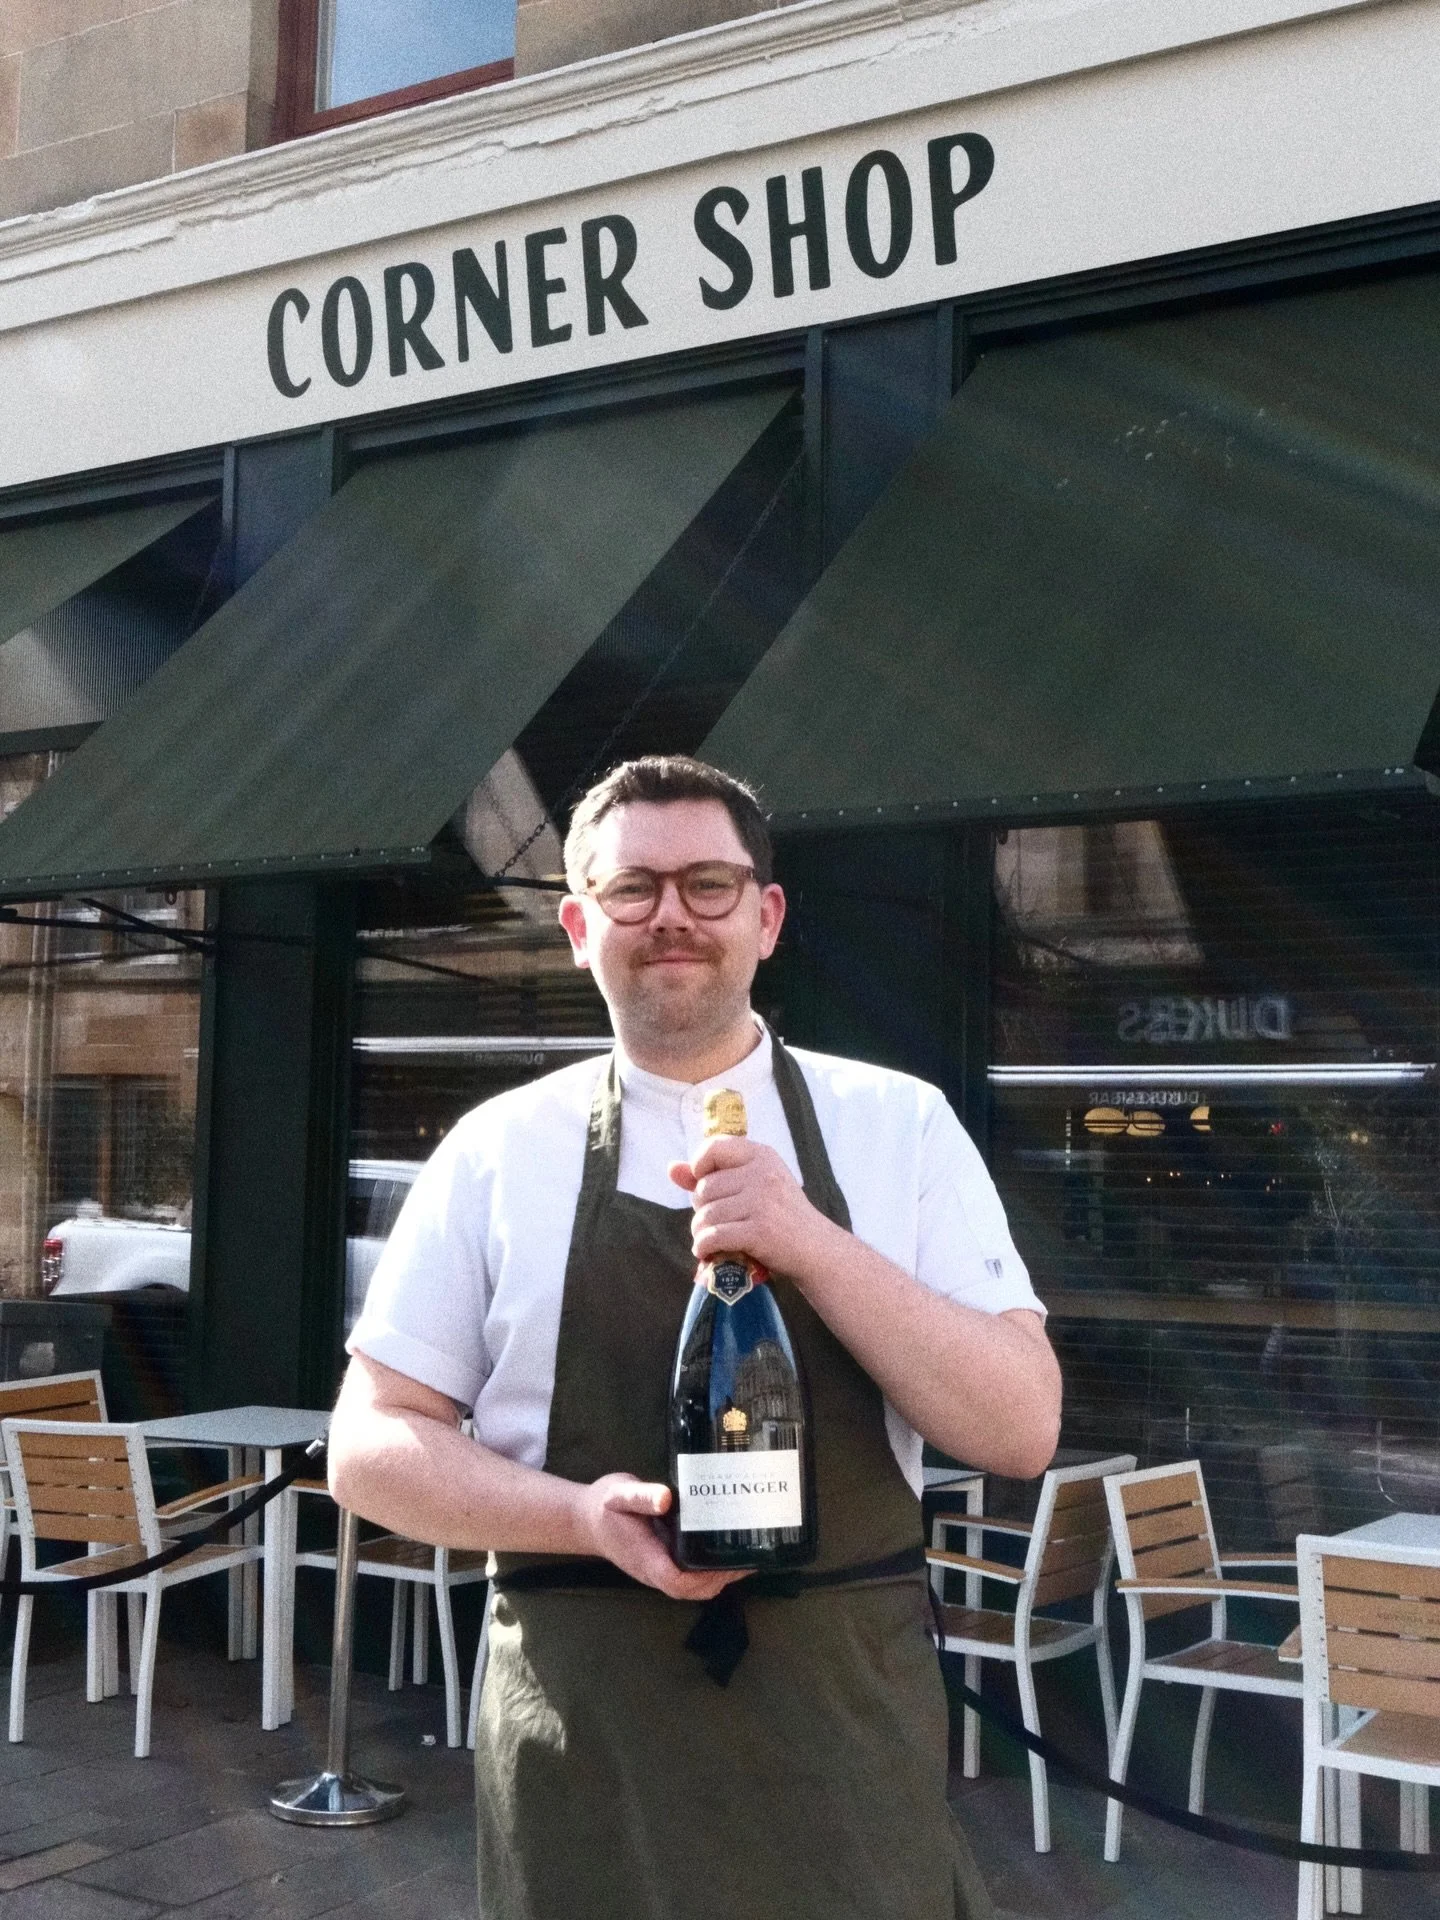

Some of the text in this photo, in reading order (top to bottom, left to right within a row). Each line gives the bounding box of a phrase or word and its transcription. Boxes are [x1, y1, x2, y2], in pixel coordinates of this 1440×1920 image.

[267, 132, 995, 399] CORNER SHOP
[689, 1480, 789, 1497] BOLLINGER
